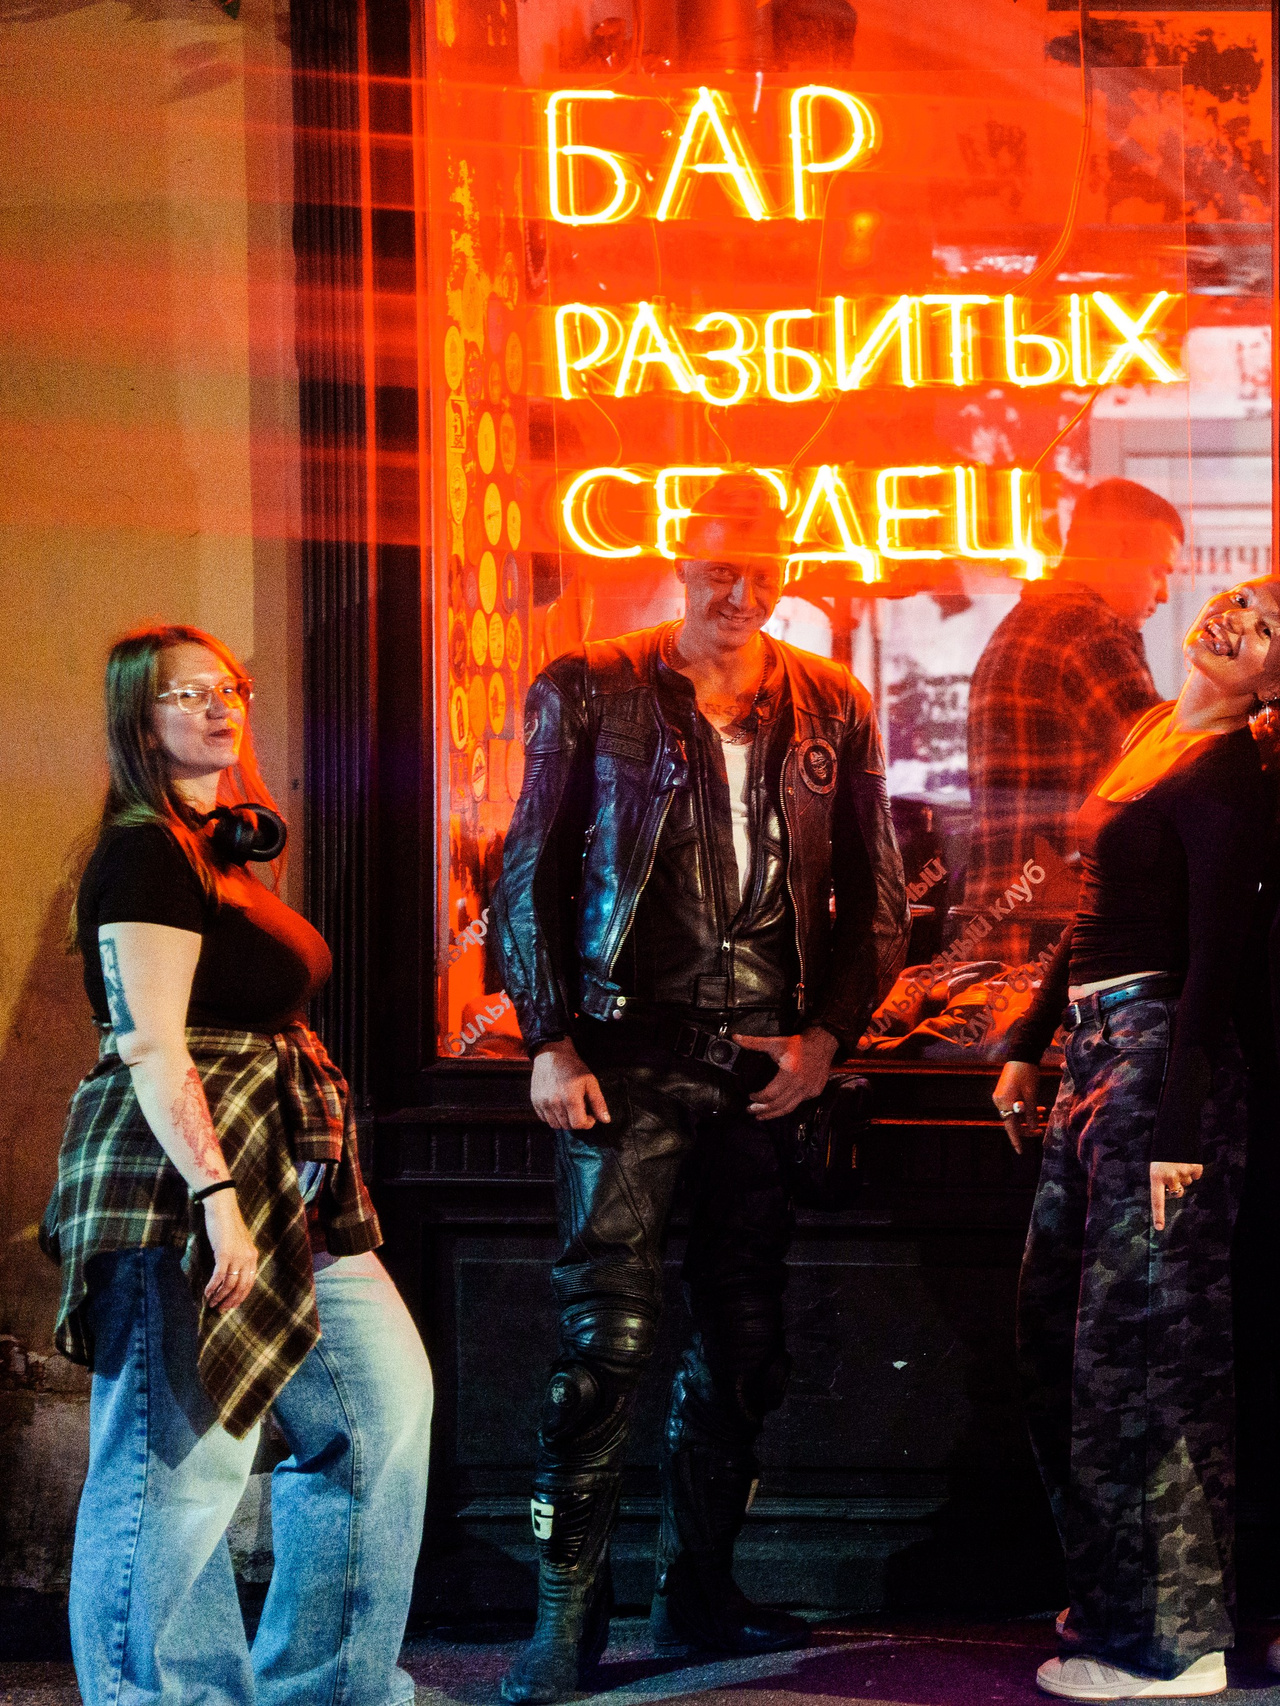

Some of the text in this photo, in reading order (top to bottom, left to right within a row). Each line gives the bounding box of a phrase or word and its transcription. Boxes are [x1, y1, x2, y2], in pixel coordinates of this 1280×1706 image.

[546, 84, 876, 226] БАР
[553, 289, 1184, 406] РАЗБИТЫХ
[989, 858, 1046, 921] клуб
[953, 990, 1010, 1048] клуб
